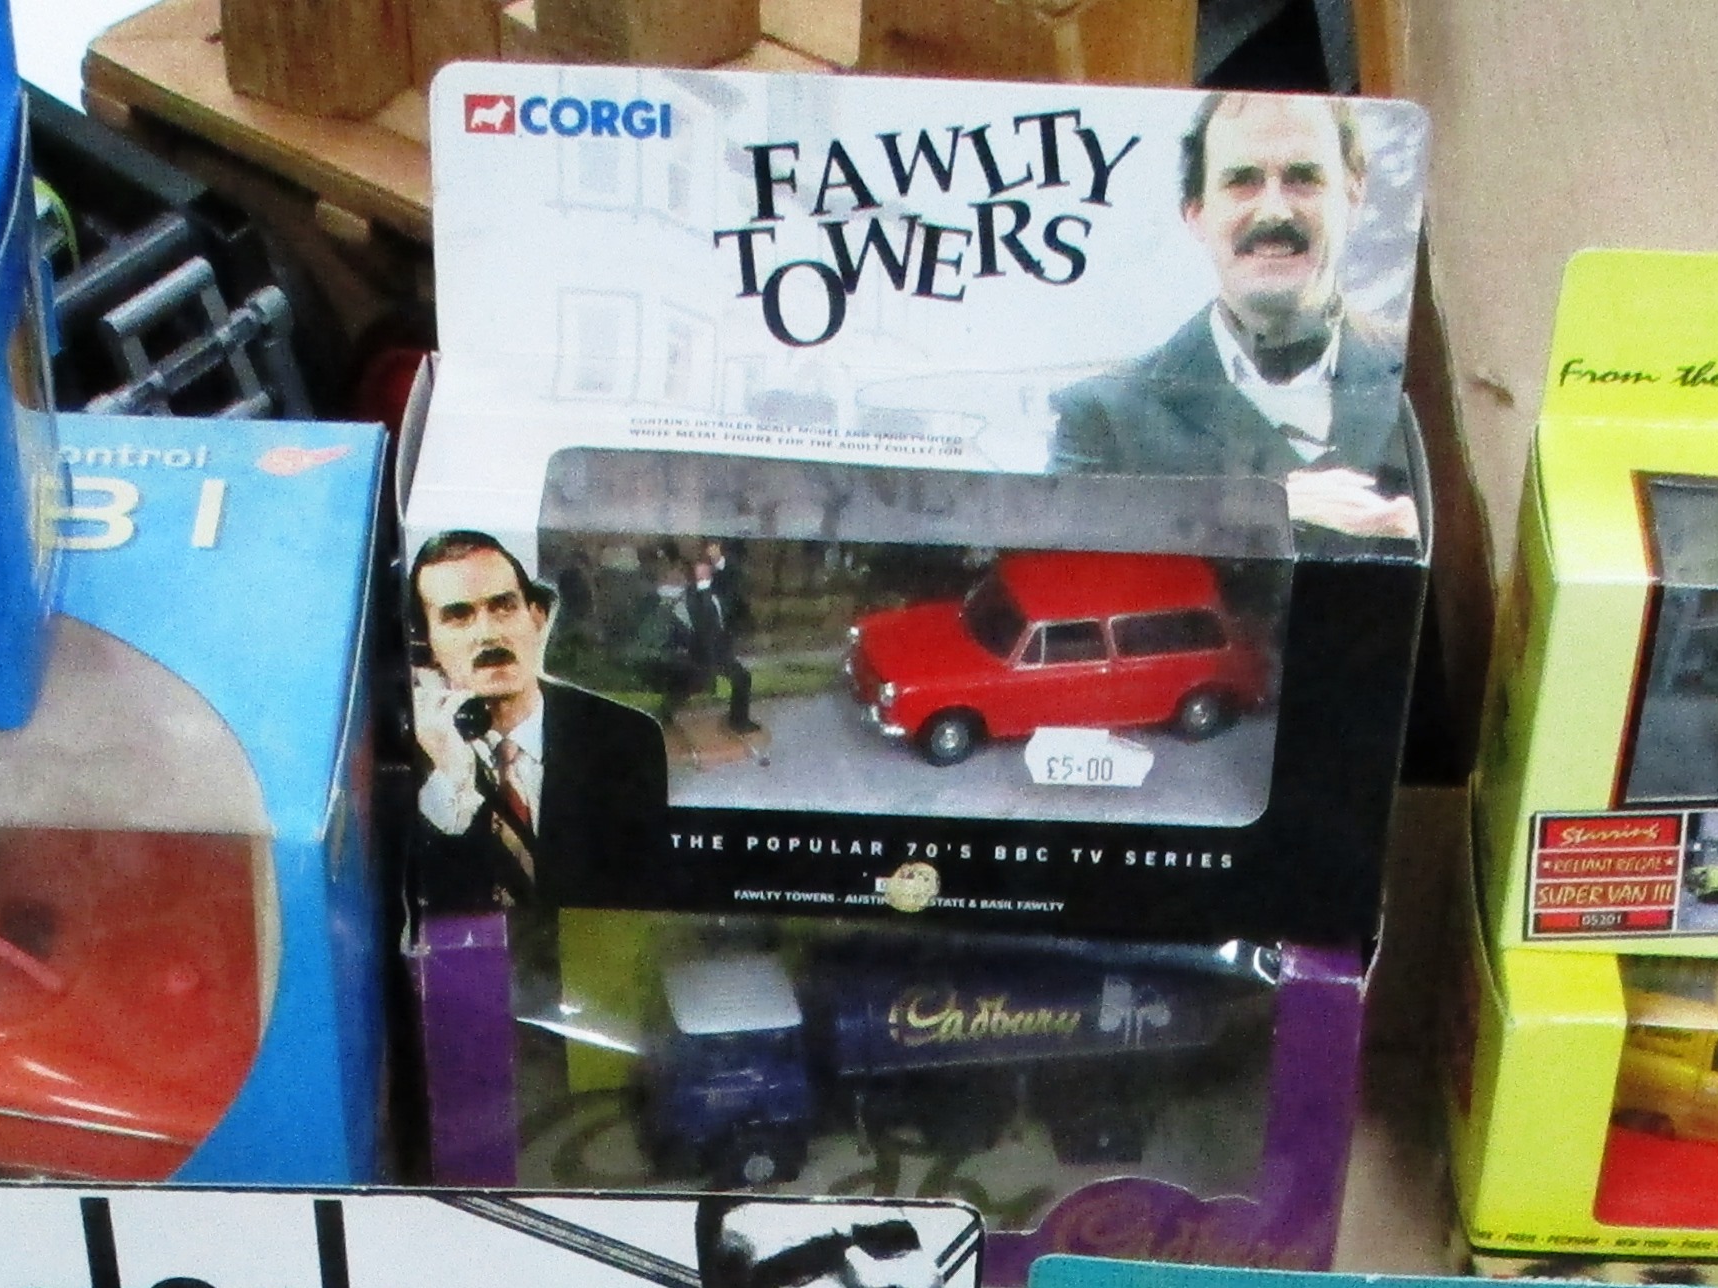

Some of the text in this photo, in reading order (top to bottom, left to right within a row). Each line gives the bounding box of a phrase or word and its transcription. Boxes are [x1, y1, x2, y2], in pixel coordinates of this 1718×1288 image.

[519, 97, 672, 140] CORGI
[744, 109, 1142, 224] FAWLTY
[714, 200, 1094, 347] TOWERS
[1560, 358, 1658, 388] From
[1561, 822, 1661, 848] Starring
[671, 834, 1234, 869] THE POPULAR 70'S BBC TV SERIES
[734, 890, 781, 901] FAWLTY
[784, 891, 836, 904] TOWERS
[980, 900, 1013, 911] BASIL
[1016, 901, 1065, 912] FAWLTY
[1536, 884, 1595, 907] SUPER
[1603, 883, 1646, 905] VAN
